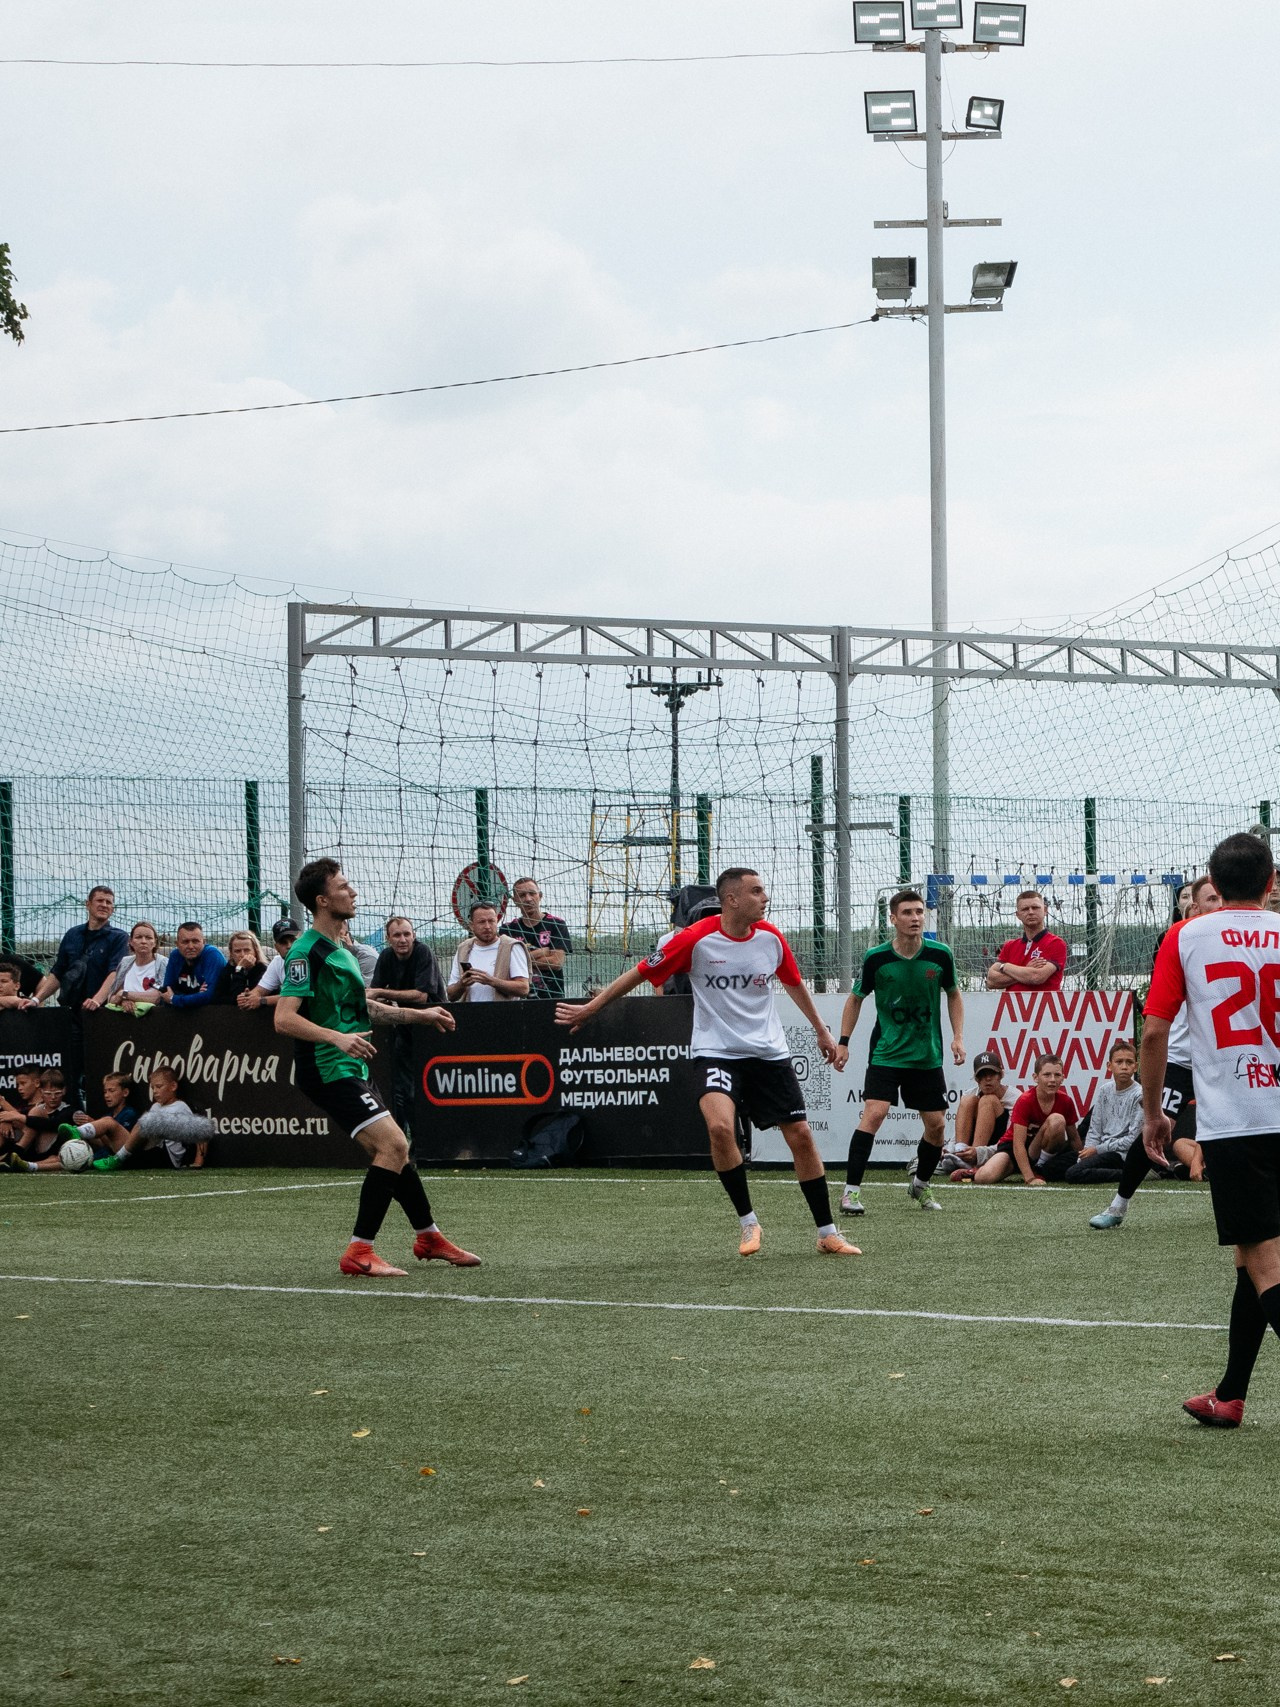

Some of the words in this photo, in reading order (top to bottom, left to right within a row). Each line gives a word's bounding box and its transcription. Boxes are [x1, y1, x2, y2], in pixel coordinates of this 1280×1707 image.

[1220, 928, 1280, 949] ФИЛ
[434, 1068, 517, 1094] Winline
[559, 1067, 670, 1085] ФУТБОЛЬНАЯ
[706, 1067, 733, 1093] 25
[360, 1093, 379, 1111] 5
[560, 1090, 659, 1110] МЕДИАЛИГА
[1161, 1087, 1183, 1114] 12
[205, 1107, 330, 1136] heeseone.ru
